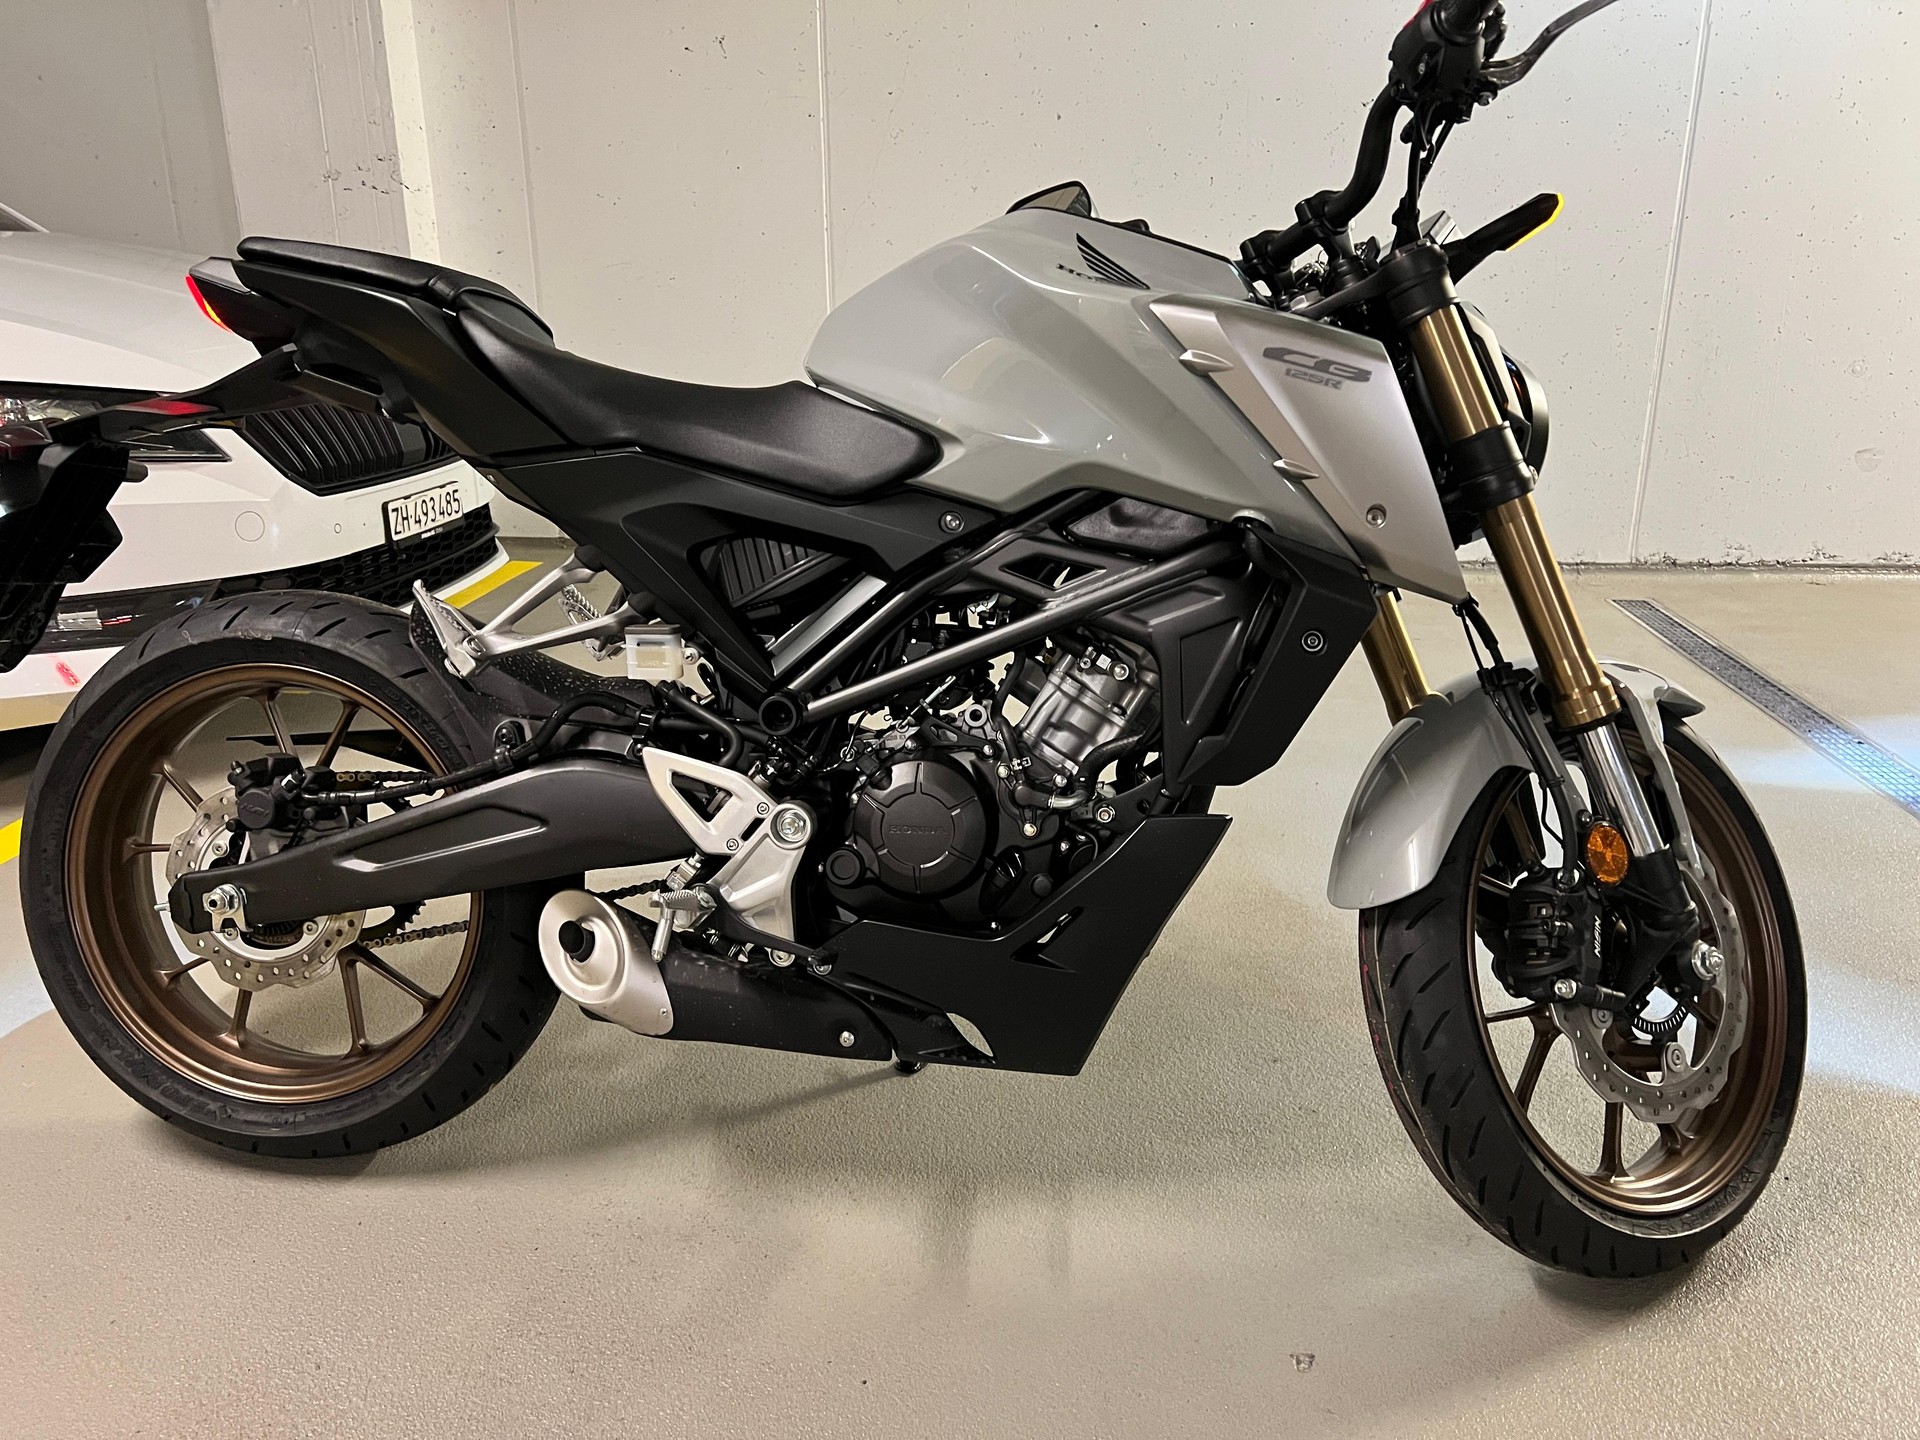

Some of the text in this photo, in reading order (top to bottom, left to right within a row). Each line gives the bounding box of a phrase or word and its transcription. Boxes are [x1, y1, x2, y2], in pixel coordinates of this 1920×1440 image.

[1263, 347, 1372, 382] CB
[1285, 368, 1342, 390] 125R
[889, 824, 950, 835] HONDA
